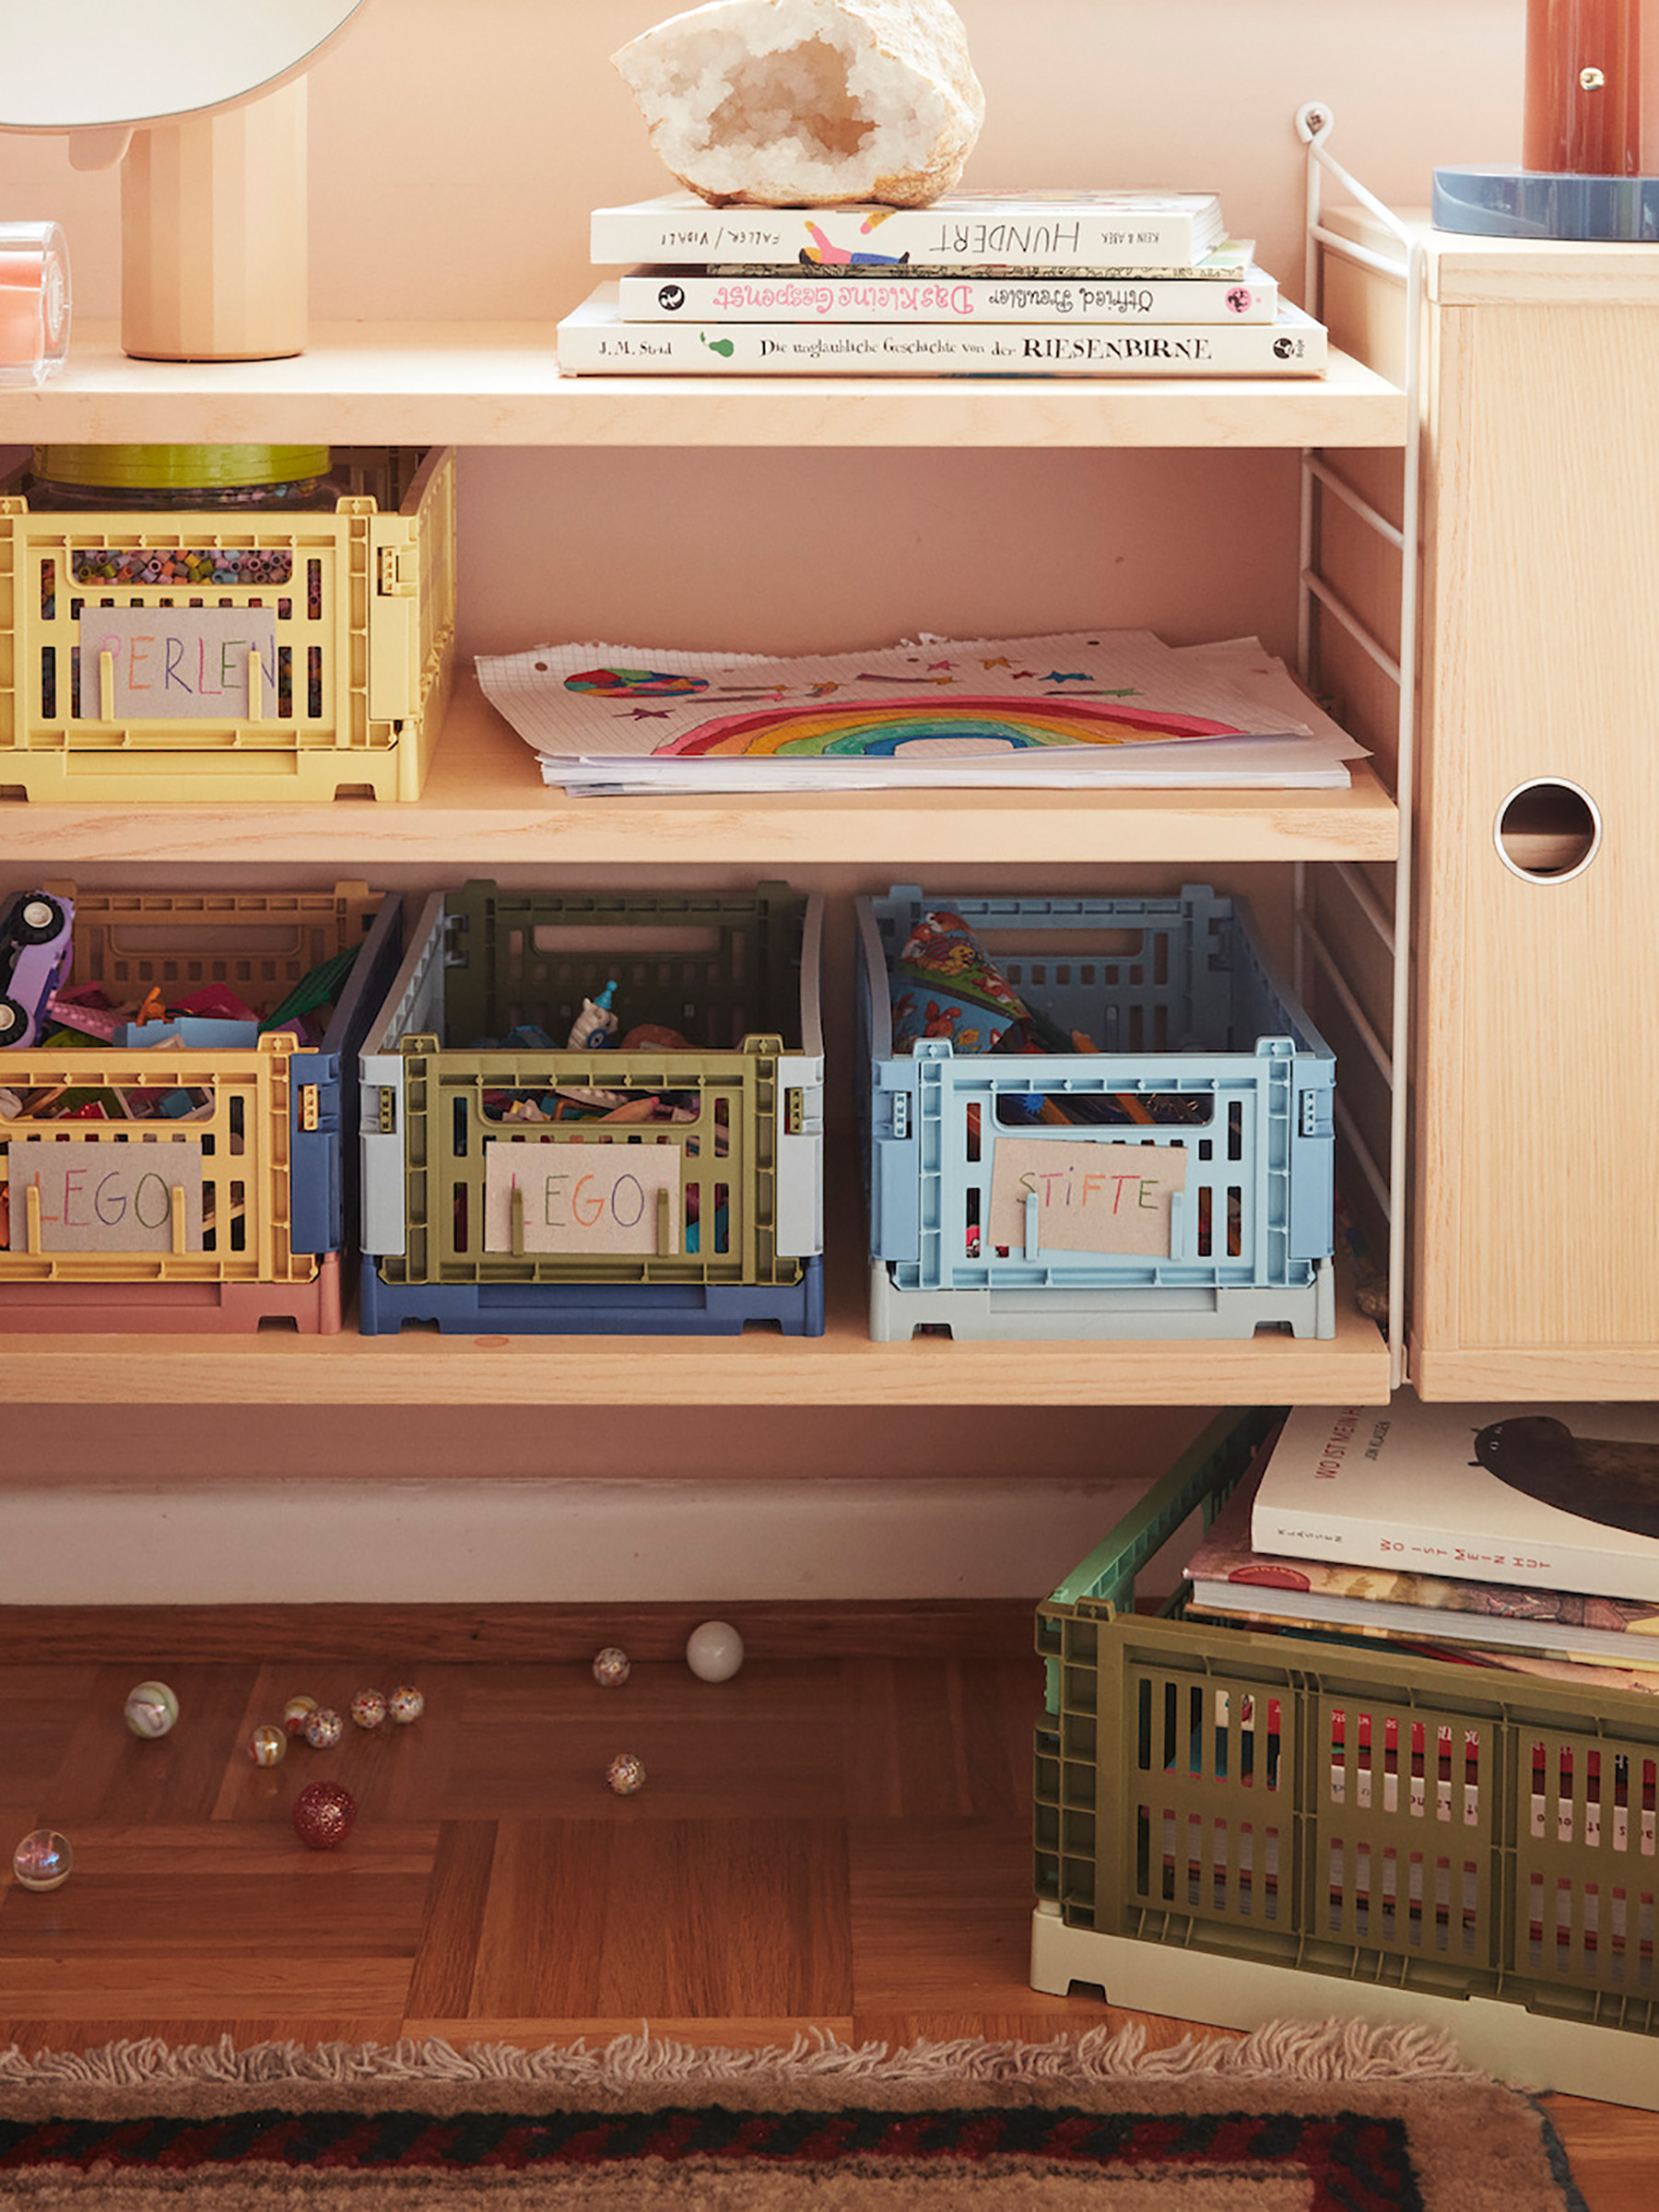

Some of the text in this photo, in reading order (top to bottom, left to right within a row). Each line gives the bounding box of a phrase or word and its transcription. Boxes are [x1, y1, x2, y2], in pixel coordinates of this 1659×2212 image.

[661, 231, 709, 245] VIDALI
[727, 230, 781, 245] FALLER
[929, 221, 1080, 253] HUNDERT
[1136, 232, 1160, 244] KEIN
[712, 285, 834, 314] Gespenst
[1078, 288, 1154, 312] Otfried
[759, 336, 1212, 360] Die unglaubliche Geschichte von der RIESENBIRNE
[1330, 1417, 1359, 1442] MEIN
[1323, 1442, 1347, 1459] IST
[1314, 1460, 1340, 1479] WO
[1380, 1538, 1551, 1569] WO IST MEIN HUT
